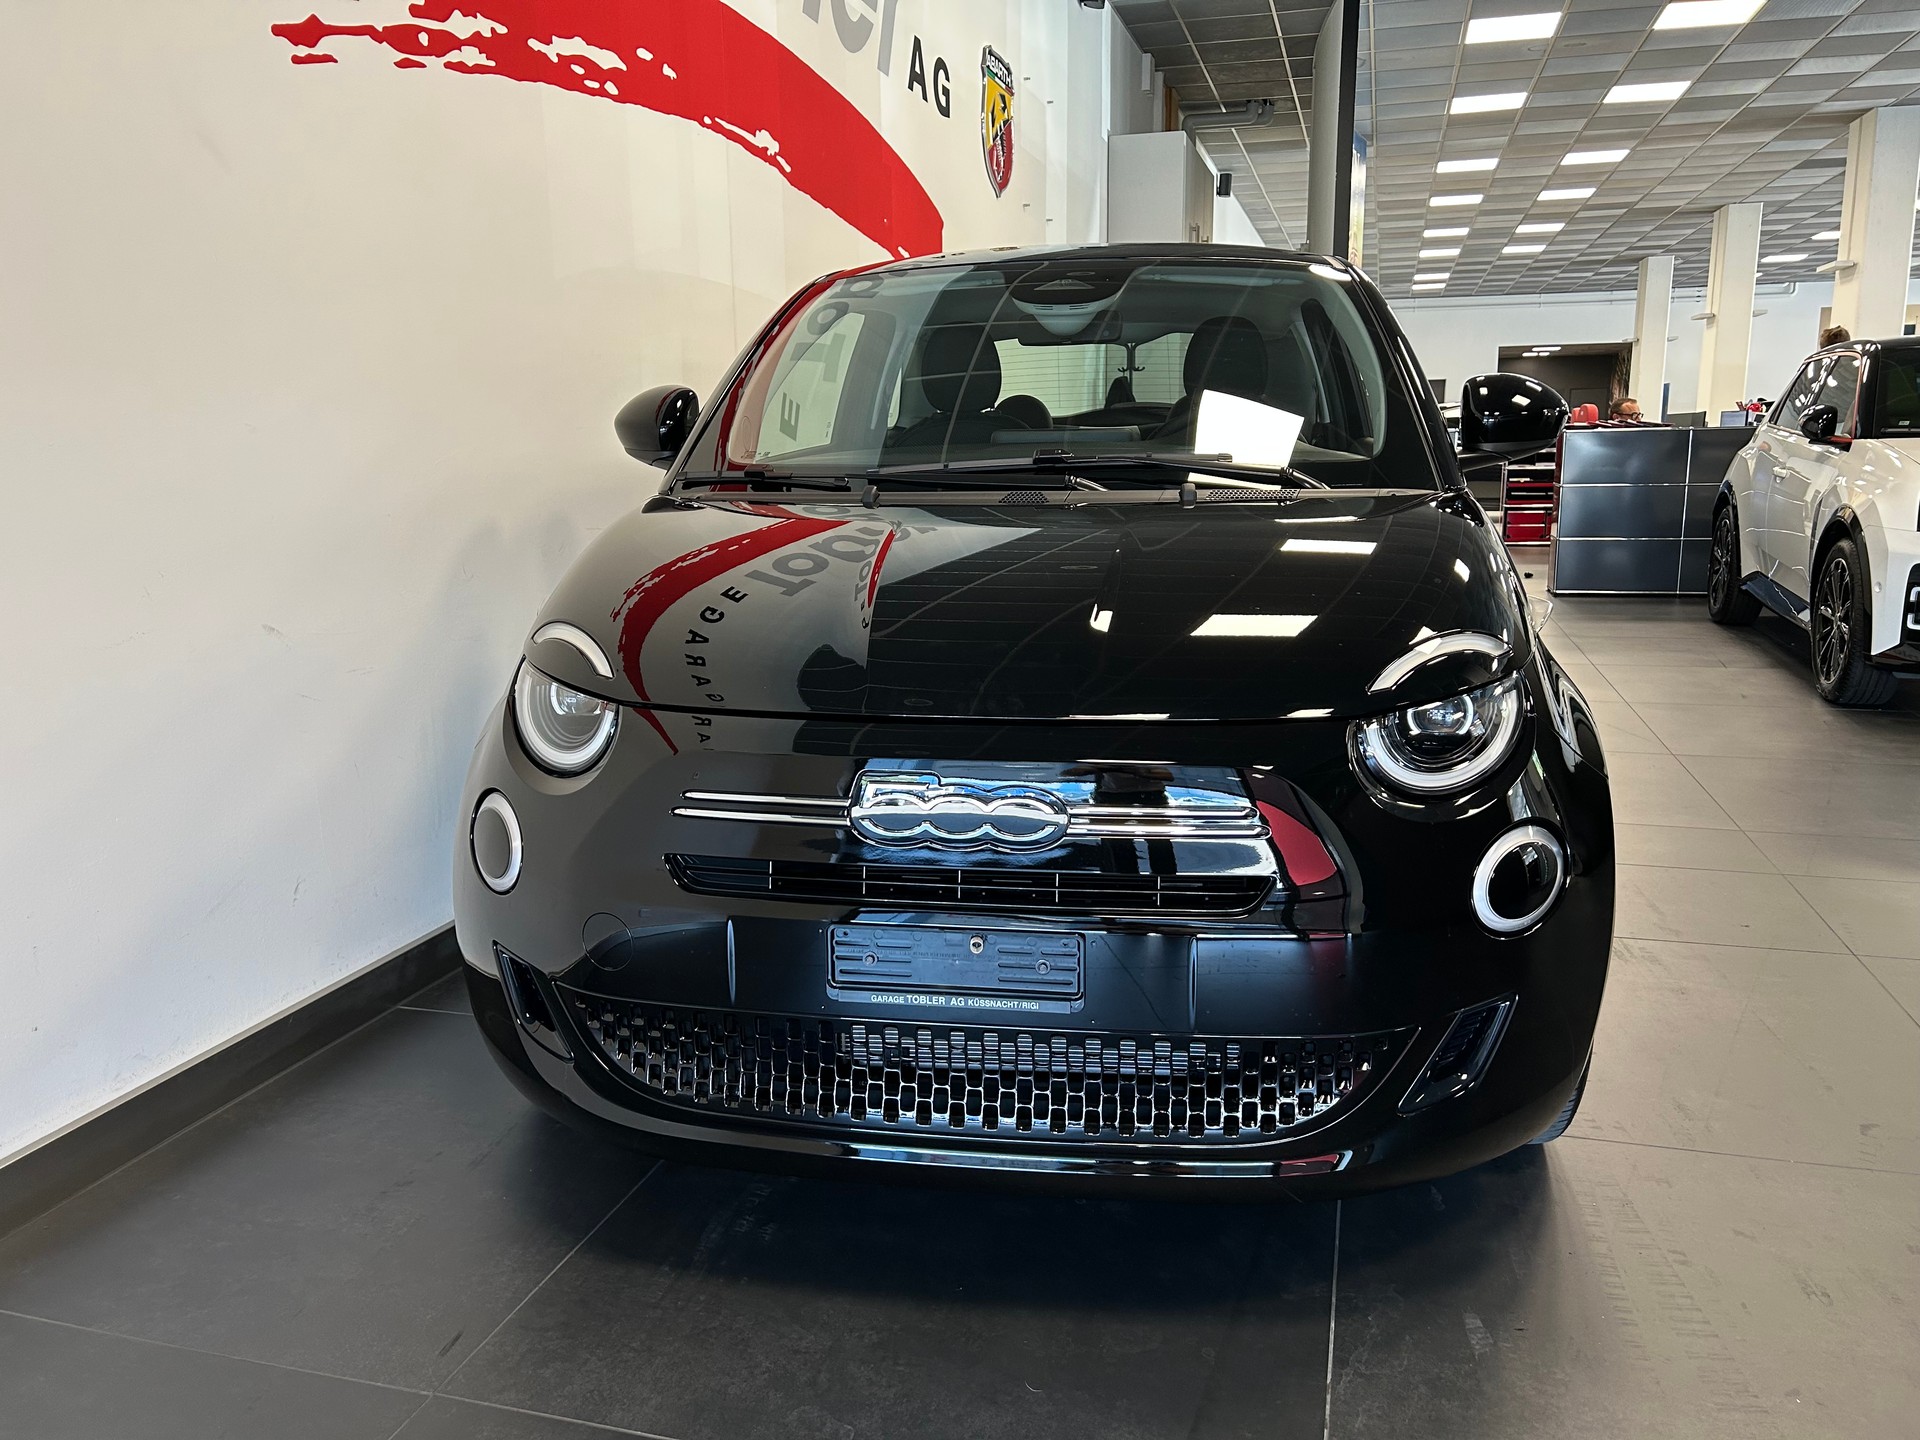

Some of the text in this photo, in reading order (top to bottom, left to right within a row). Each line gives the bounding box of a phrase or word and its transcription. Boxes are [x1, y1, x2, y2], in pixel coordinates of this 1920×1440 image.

[908, 35, 951, 119] AG
[986, 54, 1012, 88] ABARTH
[855, 776, 1063, 845] 500
[871, 994, 1039, 1010] GARAGE TOBLER AG KÜSSNACHT/RIGI
